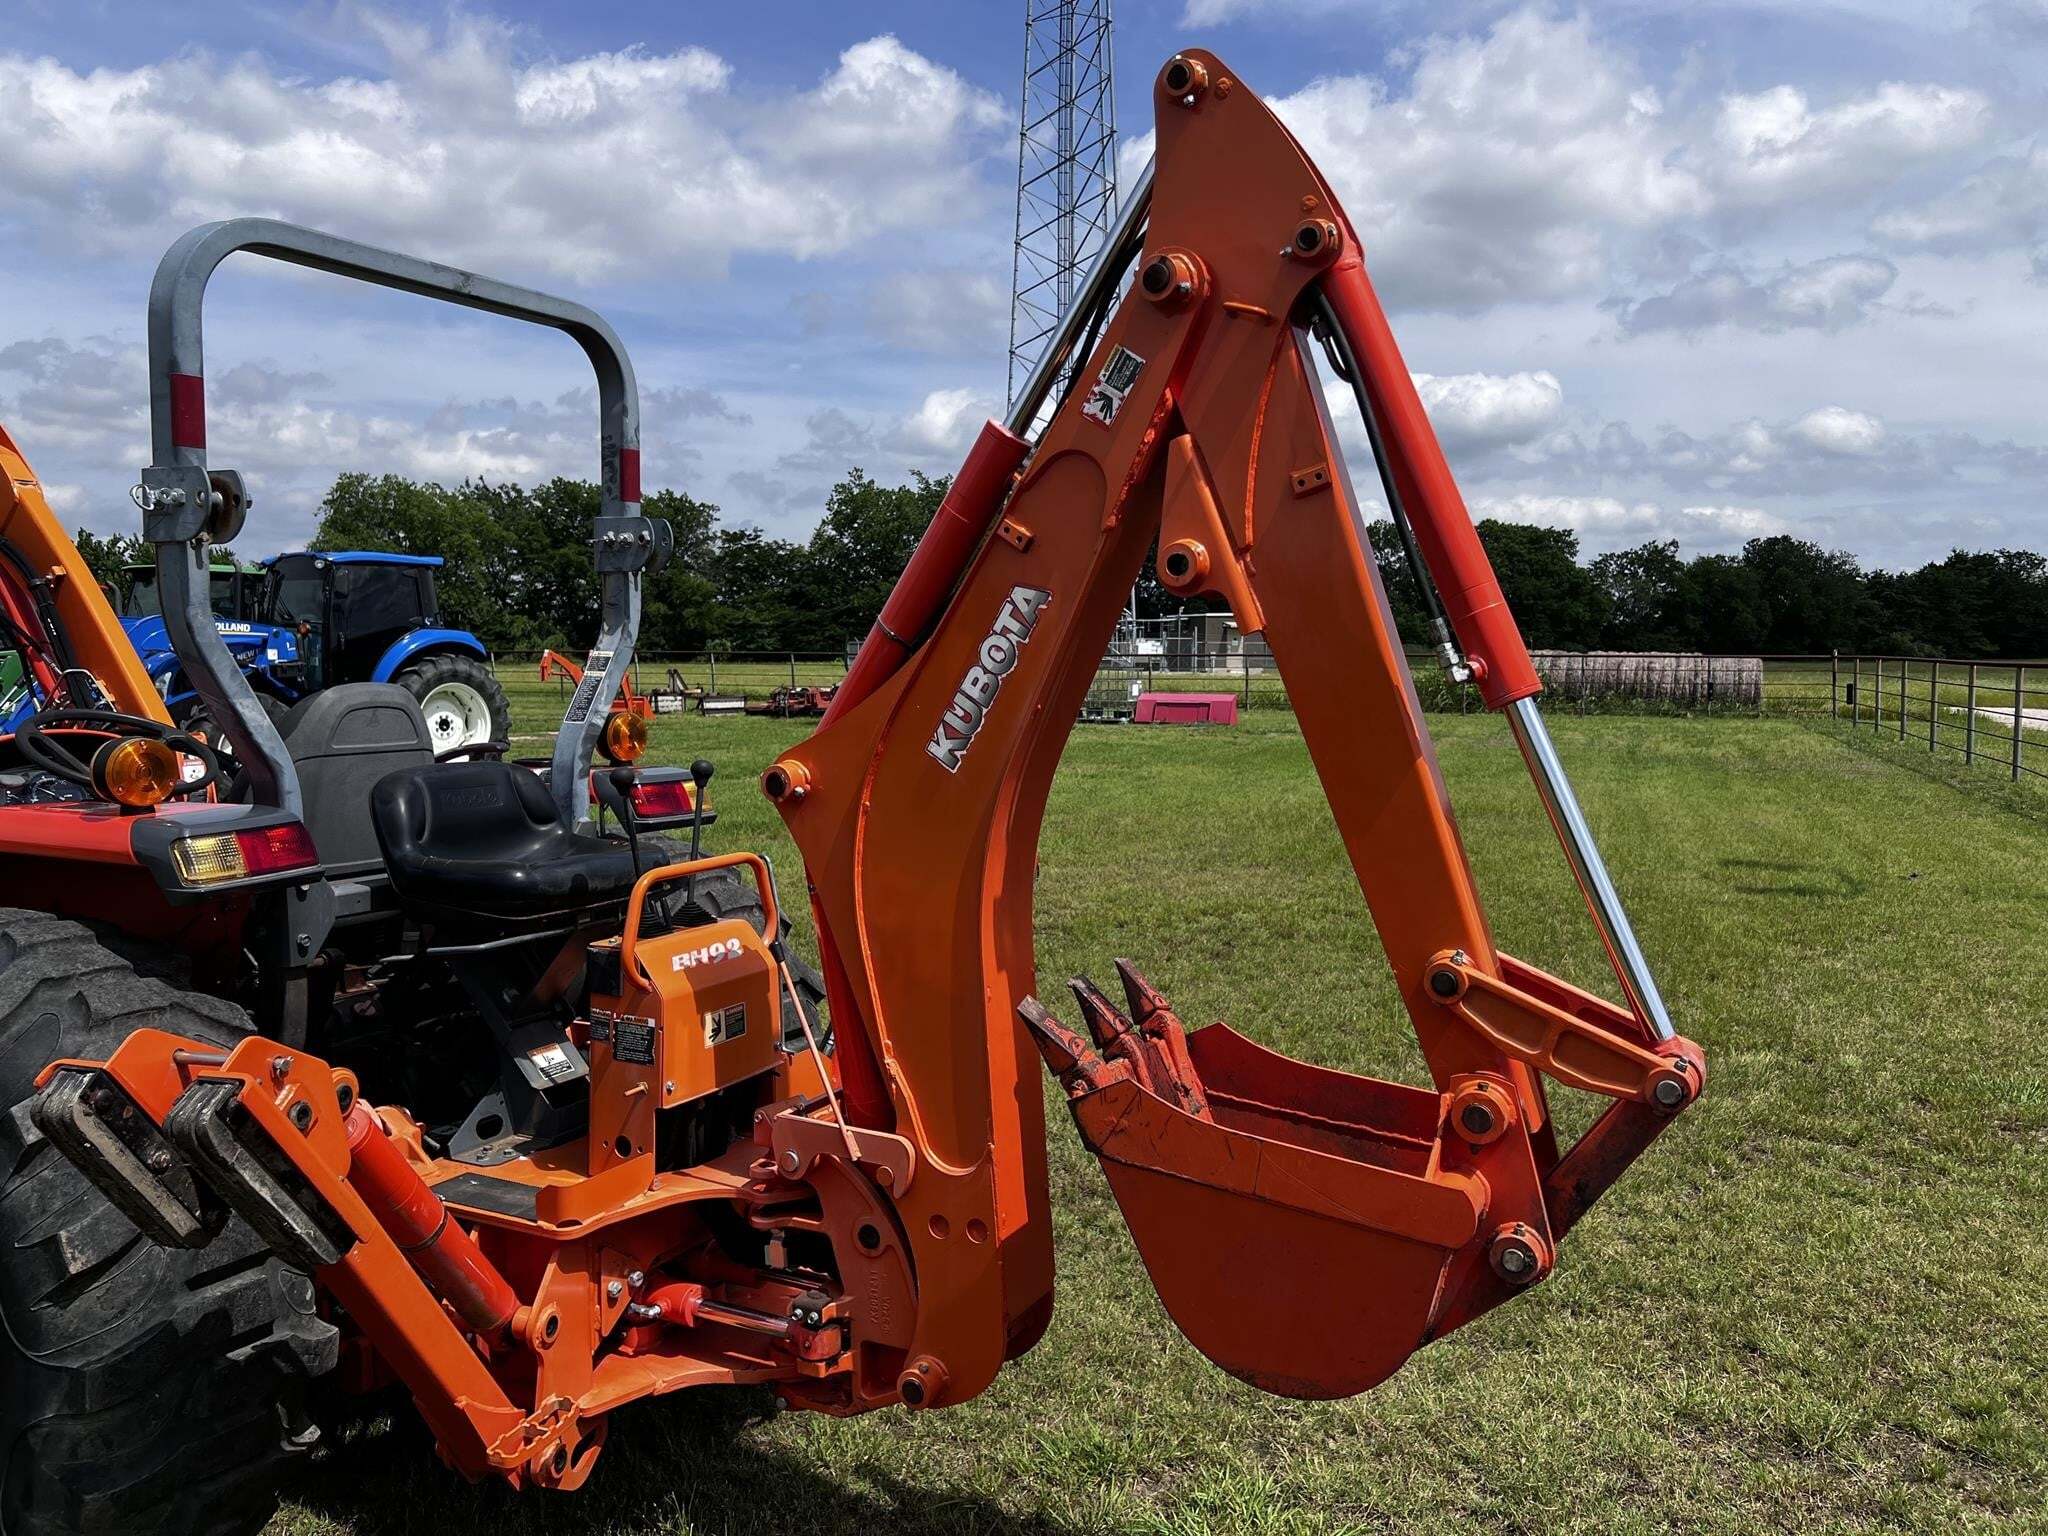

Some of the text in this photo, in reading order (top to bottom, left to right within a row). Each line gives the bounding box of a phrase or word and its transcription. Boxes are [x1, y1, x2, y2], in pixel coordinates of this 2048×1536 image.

[214, 622, 250, 632] OLLAND
[926, 585, 1051, 771] KUBOTA
[672, 938, 744, 971] BH92
